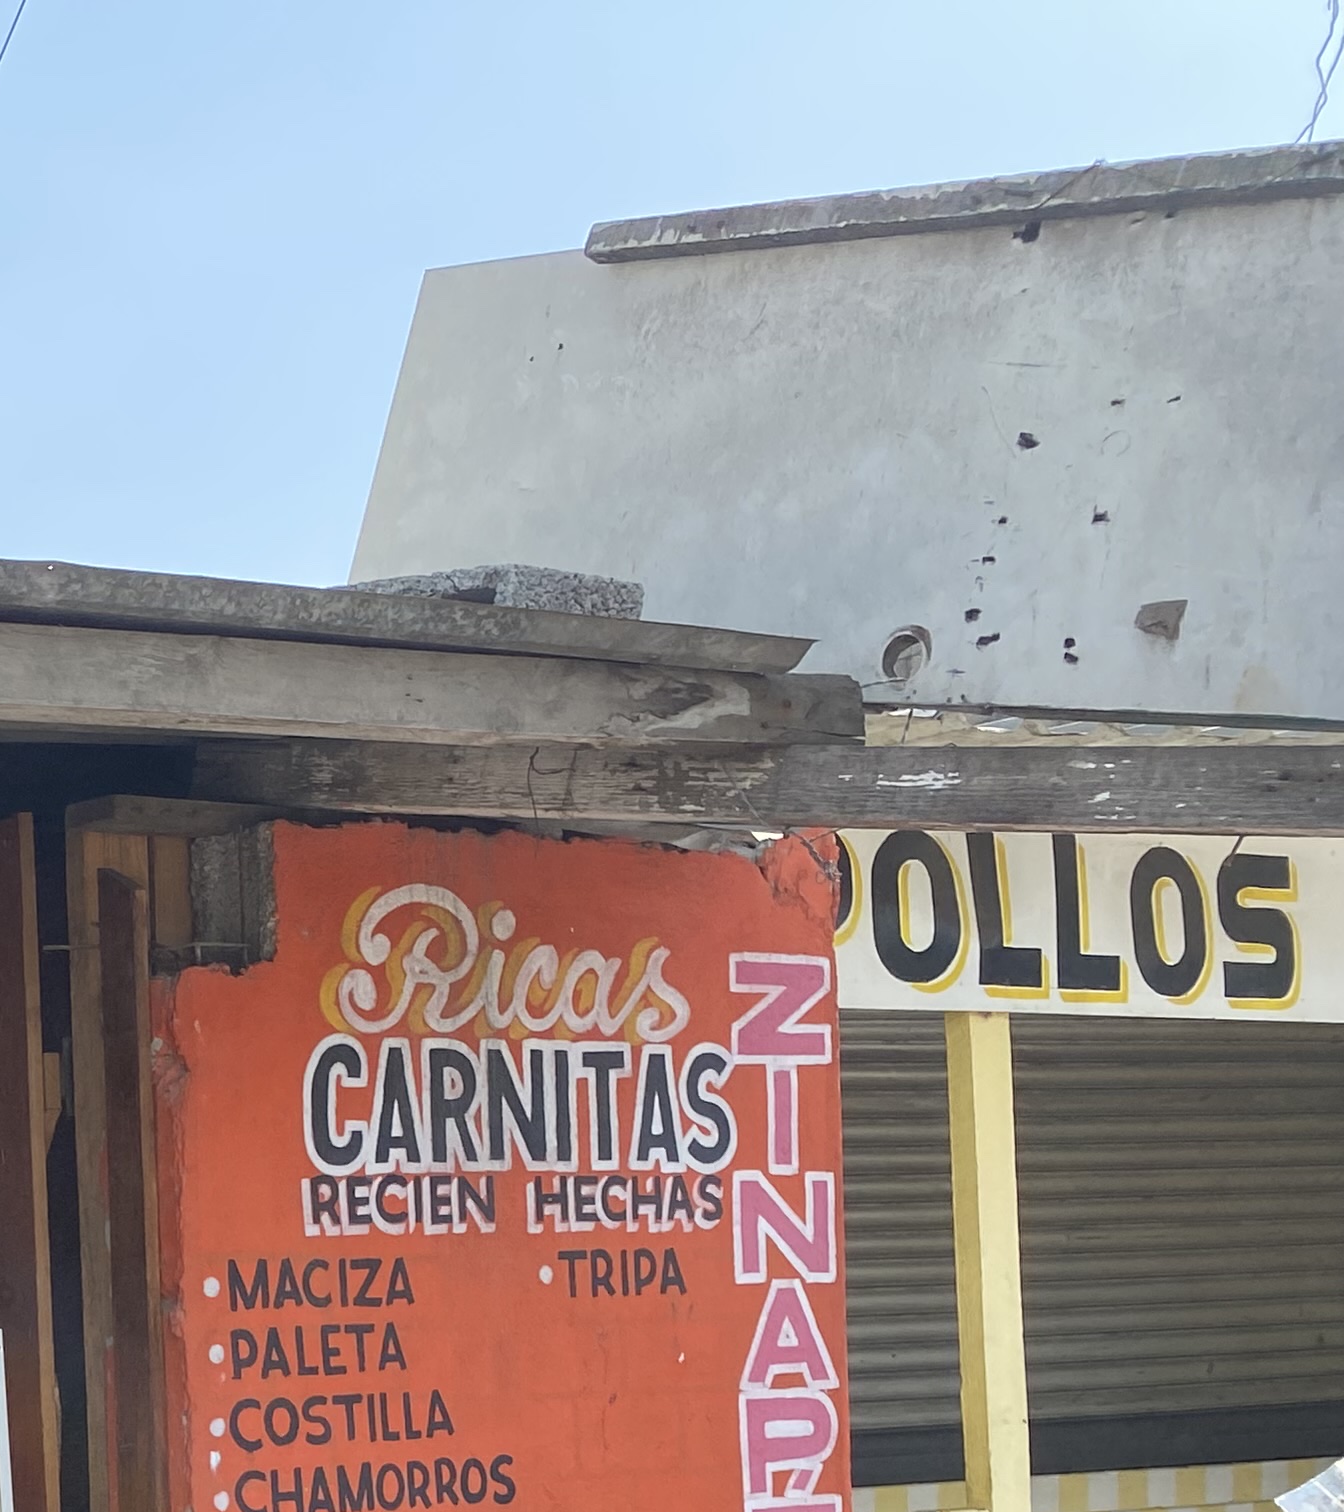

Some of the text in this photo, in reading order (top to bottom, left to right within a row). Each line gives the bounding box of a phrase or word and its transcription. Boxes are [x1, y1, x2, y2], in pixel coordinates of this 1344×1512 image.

[835, 830, 1301, 1010] OLLOS
[328, 883, 691, 1043] Ricas
[304, 1032, 738, 1174] CARNITAS
[302, 1173, 724, 1237] RECIEN HECHAS
[226, 1255, 416, 1312] MACIZA
[556, 1246, 687, 1298] TRIPA
[229, 1320, 408, 1381] PALETA
[228, 1389, 455, 1453] COSTILLA
